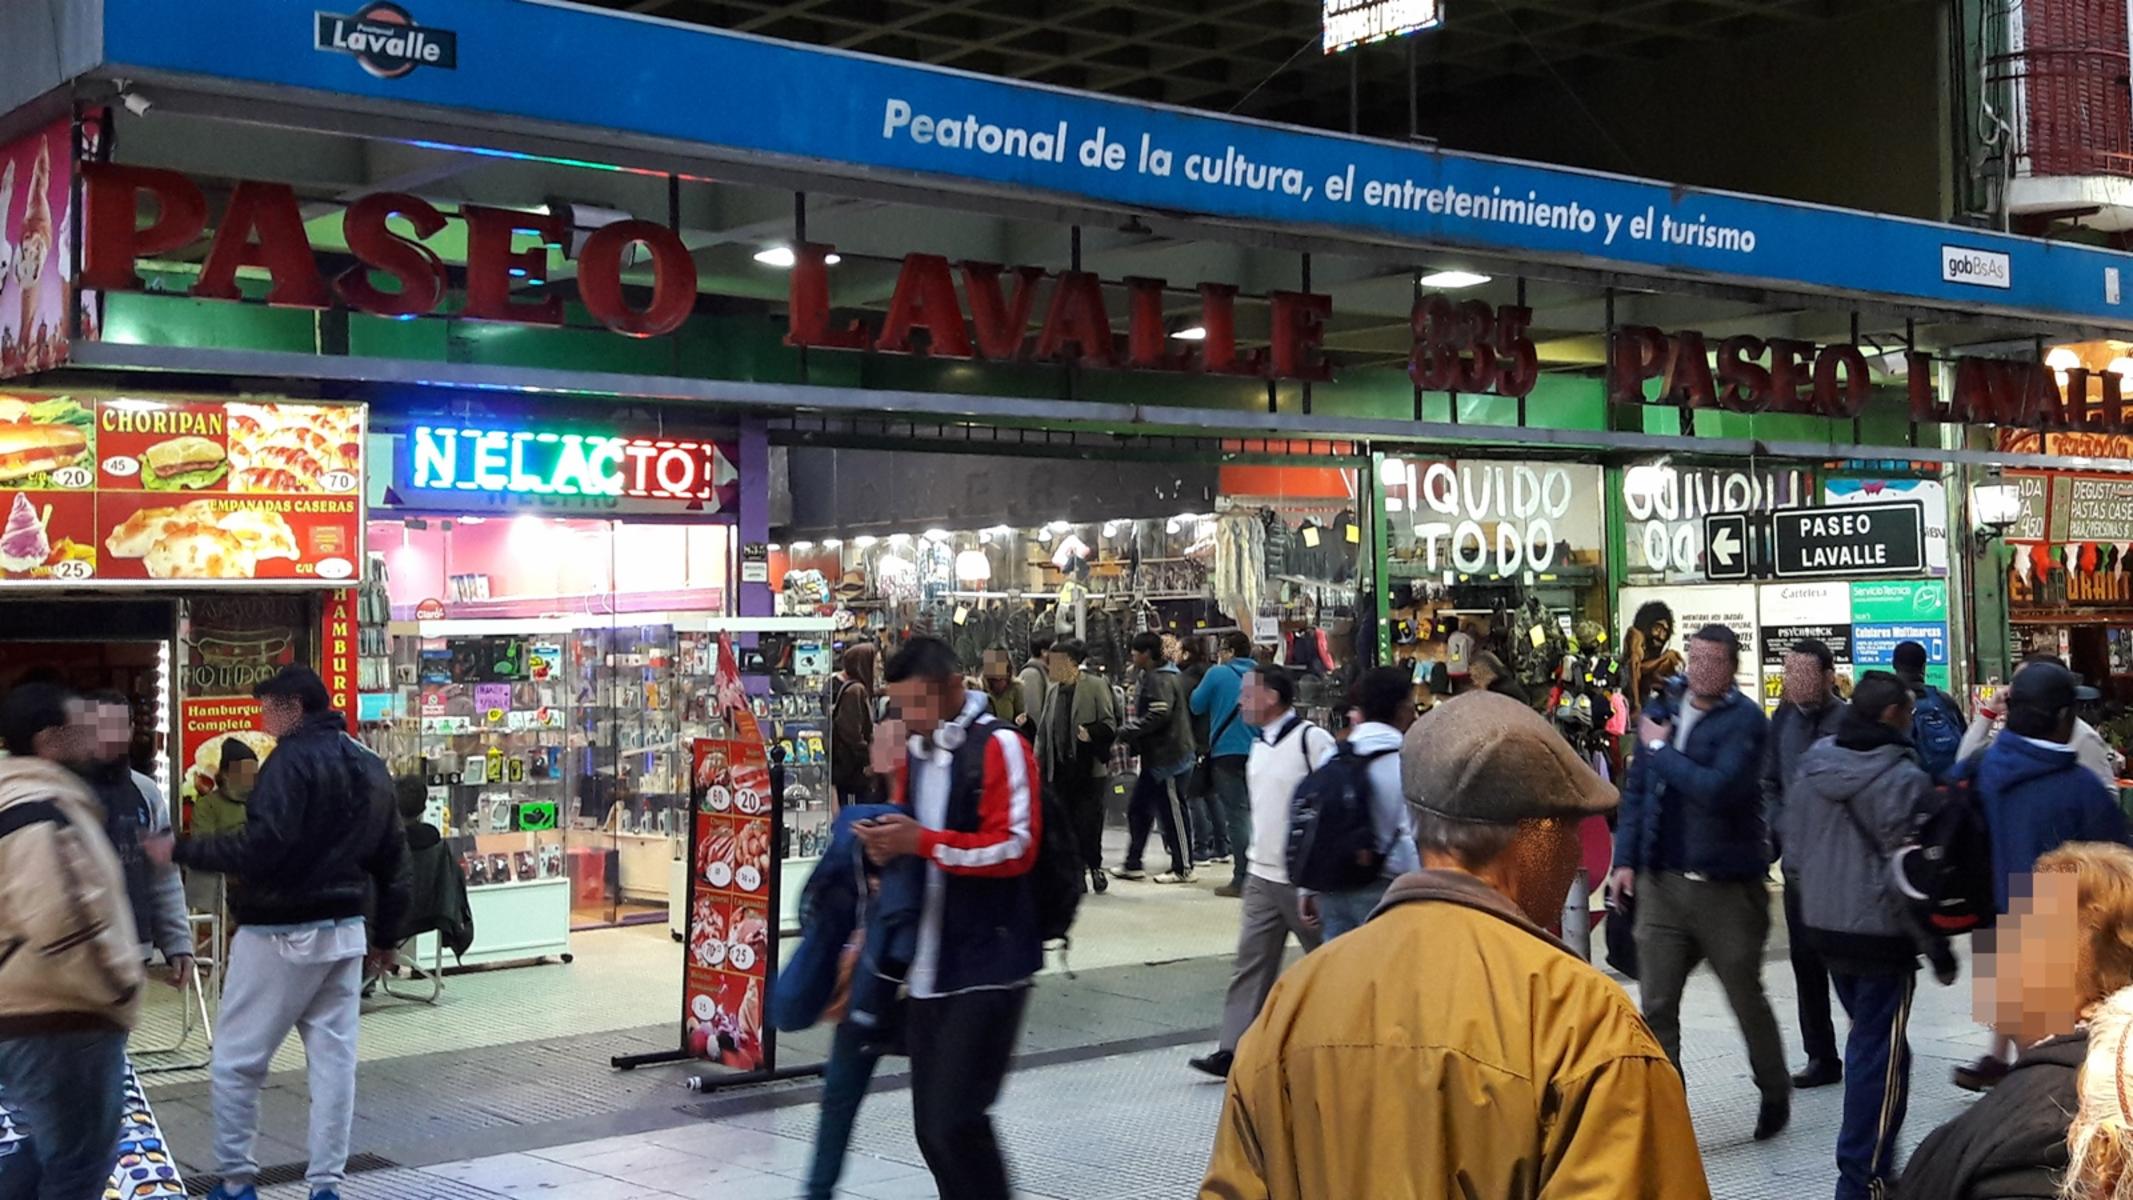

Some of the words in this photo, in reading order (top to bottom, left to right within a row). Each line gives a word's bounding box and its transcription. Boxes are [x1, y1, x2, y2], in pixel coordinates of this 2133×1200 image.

[333, 20, 441, 61] Lavalle
[882, 98, 1066, 162] Peatonal
[1079, 127, 1125, 171] de
[1139, 133, 1172, 177] la
[1185, 145, 1313, 202] cultura,
[1324, 165, 1353, 202] el
[1363, 178, 1595, 233] entretenimiento
[1604, 209, 1622, 245] y
[1629, 206, 1654, 240] el
[1661, 216, 1757, 252] turismo
[1949, 254, 2004, 279] gobBsAs
[78, 160, 698, 338] PASEO
[781, 242, 1337, 382] LAVALLE
[1408, 293, 1538, 397] 835
[1608, 324, 1871, 418] PASEO
[102, 408, 223, 435] CHORIPAN
[62, 470, 85, 485] 20
[110, 460, 126, 472] 45
[329, 474, 349, 488] 70
[209, 500, 292, 512] EMPANADAS
[294, 500, 355, 513] CASERAS
[2071, 501, 2106, 520] PASTAS
[1800, 513, 1871, 538] PASEO
[1414, 518, 1555, 577] TODO
[1801, 543, 1887, 568] LAVALLE
[61, 563, 84, 577] 25
[331, 584, 349, 717] HAMBURG
[187, 718, 252, 733] Completa
[740, 790, 757, 811] 20
[735, 948, 747, 963] 25
